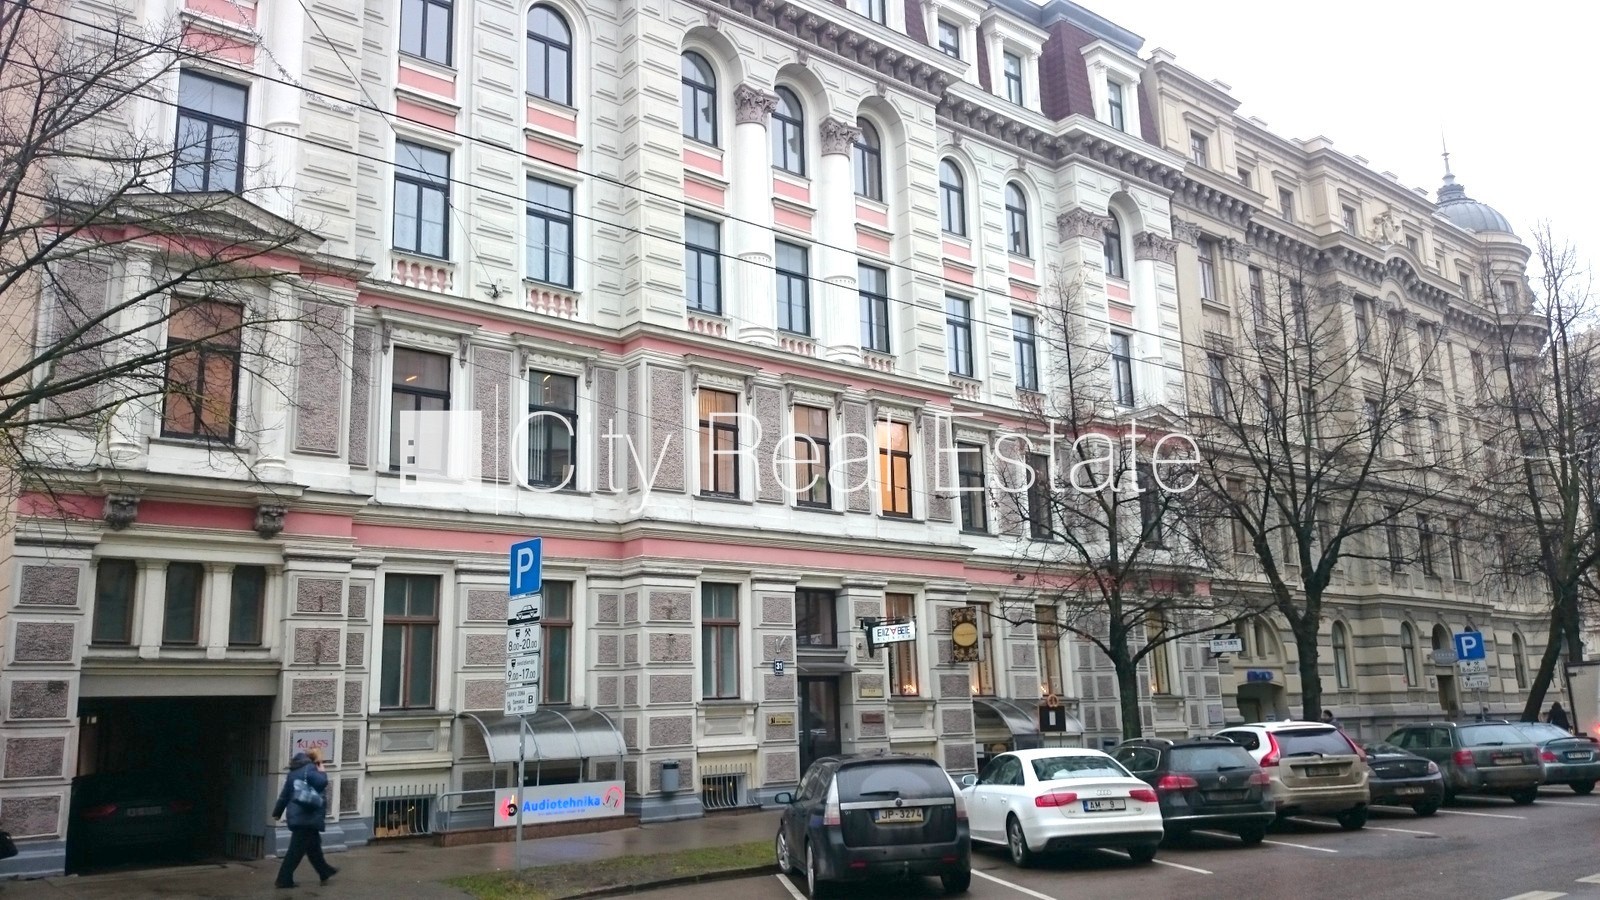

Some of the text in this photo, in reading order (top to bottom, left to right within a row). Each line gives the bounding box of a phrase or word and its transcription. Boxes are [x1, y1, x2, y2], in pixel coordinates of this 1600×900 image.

[516, 547, 534, 589] P
[1461, 636, 1477, 657] P
[528, 695, 534, 704] B
[523, 795, 601, 812] Audiotehnika
